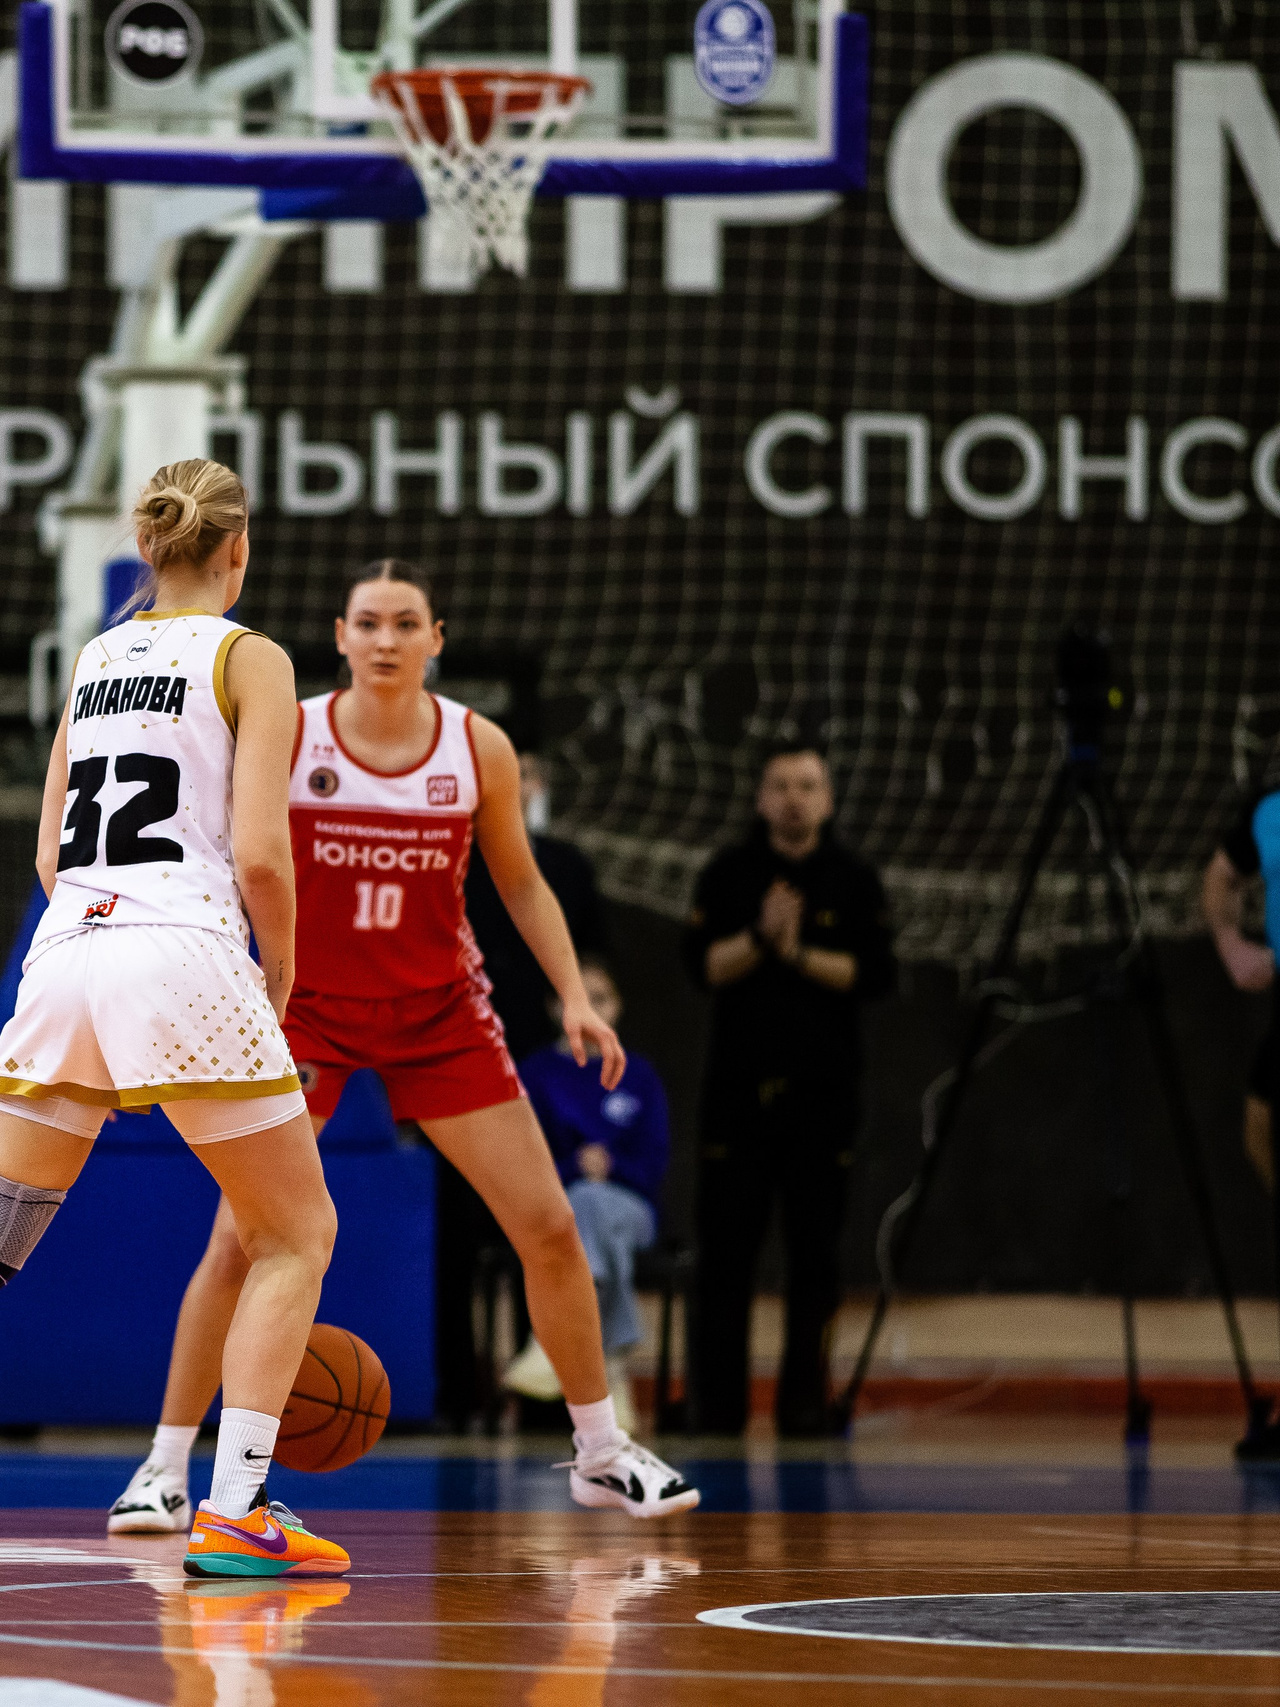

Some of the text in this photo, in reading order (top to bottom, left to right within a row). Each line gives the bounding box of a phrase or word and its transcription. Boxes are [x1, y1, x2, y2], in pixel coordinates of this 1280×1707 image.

[743, 411, 1280, 524] СПОНС
[56, 752, 184, 873] 32
[313, 838, 450, 873] ЮНОСТЬ
[352, 880, 405, 930] 10
